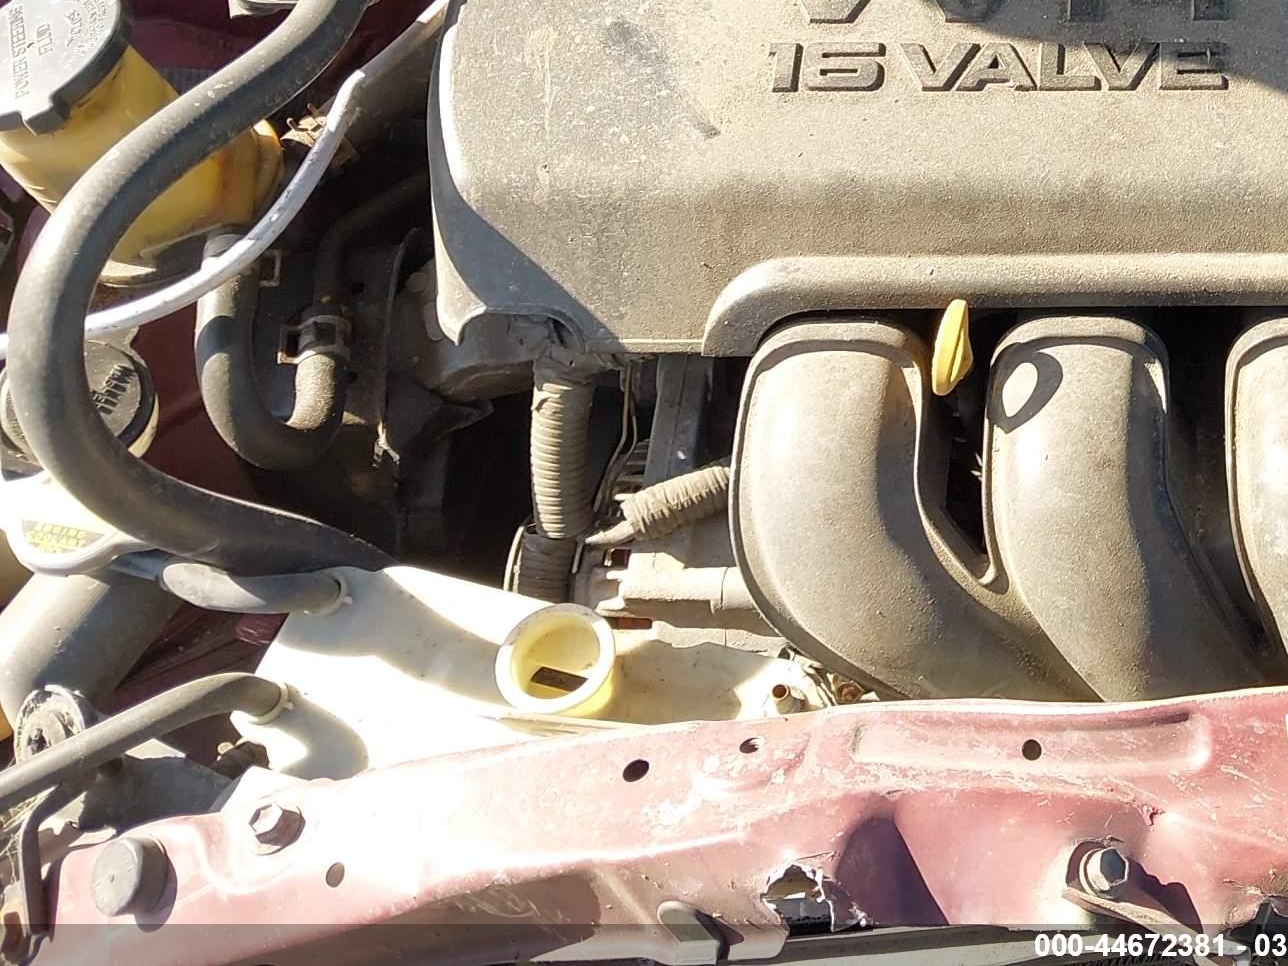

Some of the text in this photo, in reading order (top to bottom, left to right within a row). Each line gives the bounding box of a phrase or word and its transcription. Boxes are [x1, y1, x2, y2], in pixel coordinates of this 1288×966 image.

[9, 5, 29, 100] POWER STEERING
[36, 23, 53, 56] FLUID
[767, 41, 1229, 92] 16 VALVE
